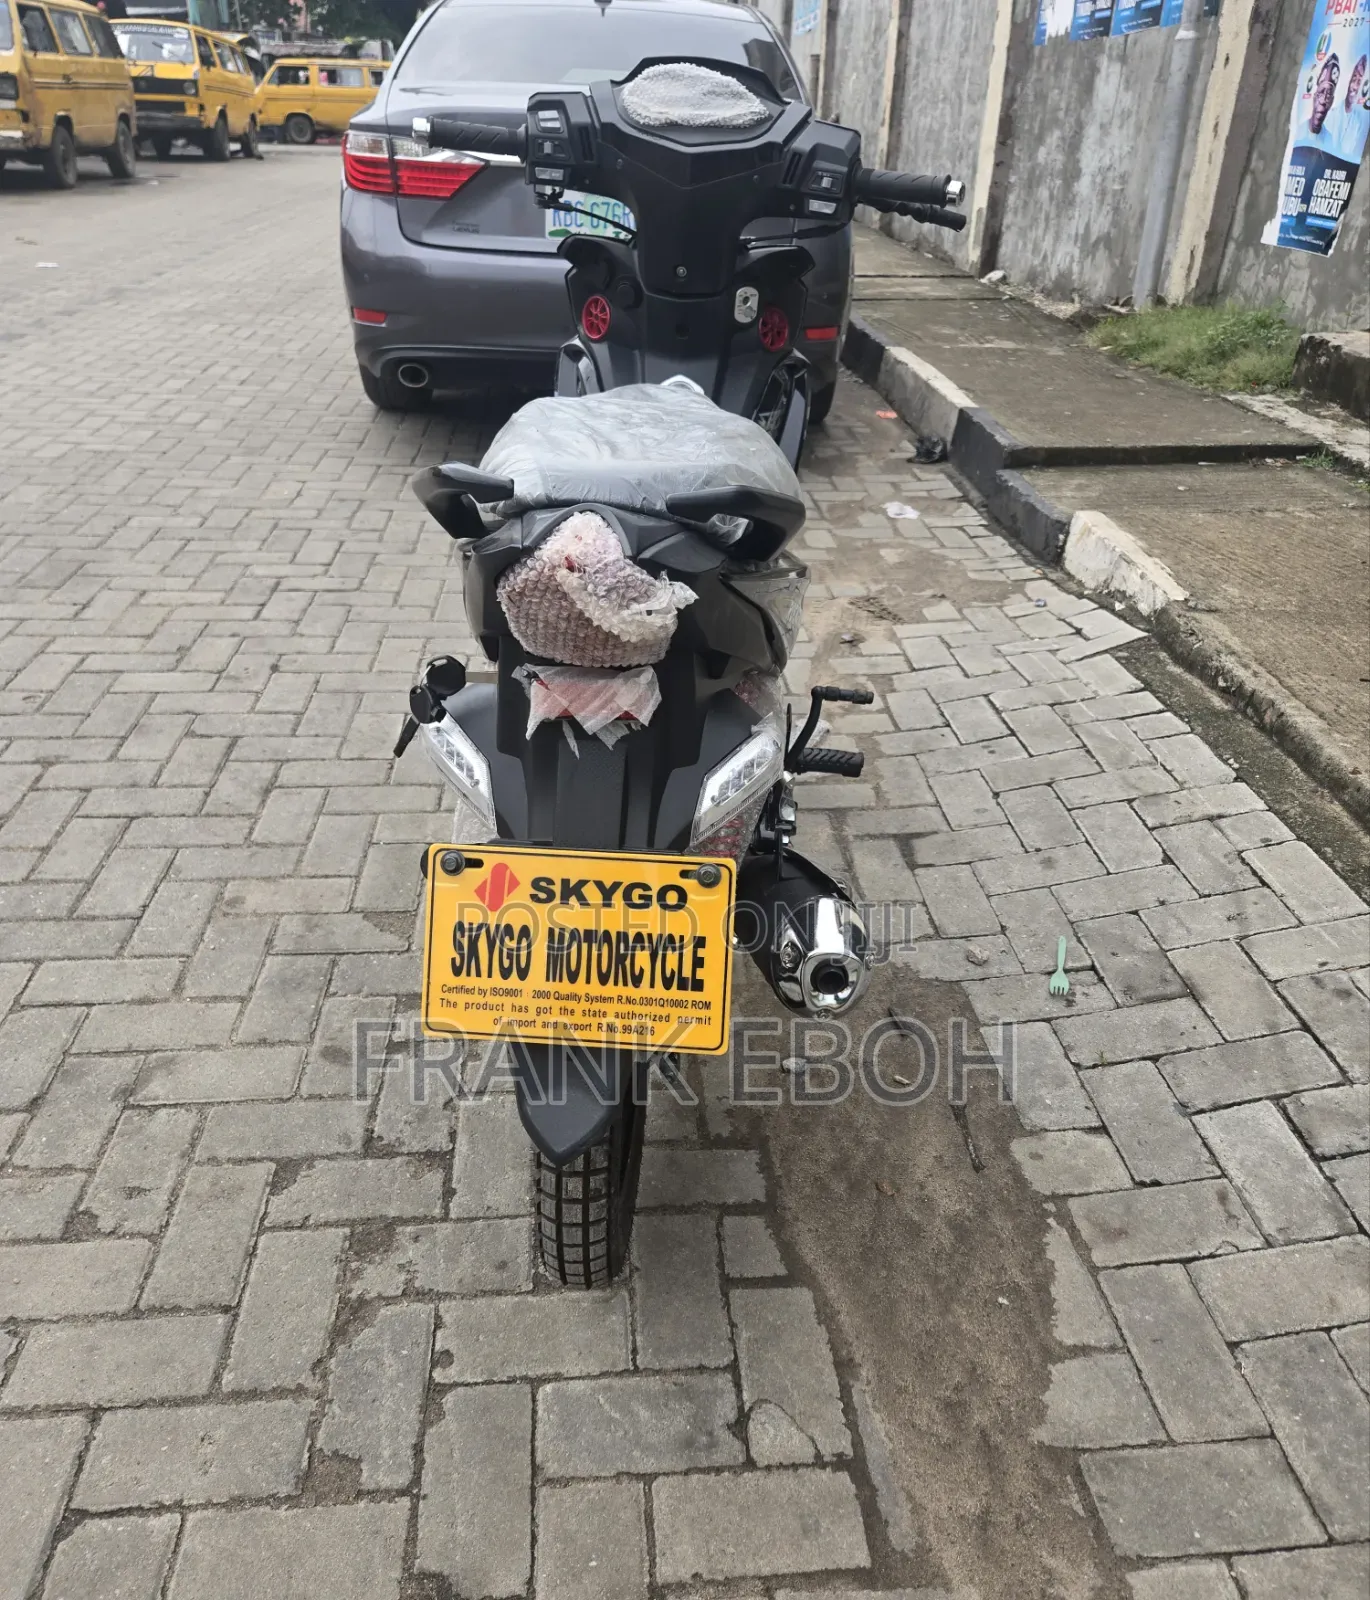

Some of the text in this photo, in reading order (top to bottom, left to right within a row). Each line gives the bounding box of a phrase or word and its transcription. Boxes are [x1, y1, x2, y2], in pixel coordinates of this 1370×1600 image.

[1342, 17, 1365, 28] 2027
[1311, 178, 1351, 201] OBAFEMI
[1307, 196, 1344, 218] HAMZAT
[529, 876, 688, 912] SKYGO
[450, 920, 707, 993] SKYGO MOTORCYCLE
[441, 984, 475, 996] Certified
[478, 986, 488, 999] by
[490, 987, 523, 998] ISO9001
[532, 989, 551, 1000] 2000
[553, 991, 582, 1004] Quality
[584, 993, 614, 1005] System
[691, 1000, 711, 1011] ROM
[439, 998, 712, 1026] The product has got the state authorized permit
[493, 1016, 503, 1027] of
[507, 1017, 537, 1029] import
[541, 1020, 558, 1030] and
[563, 1021, 592, 1033] export
